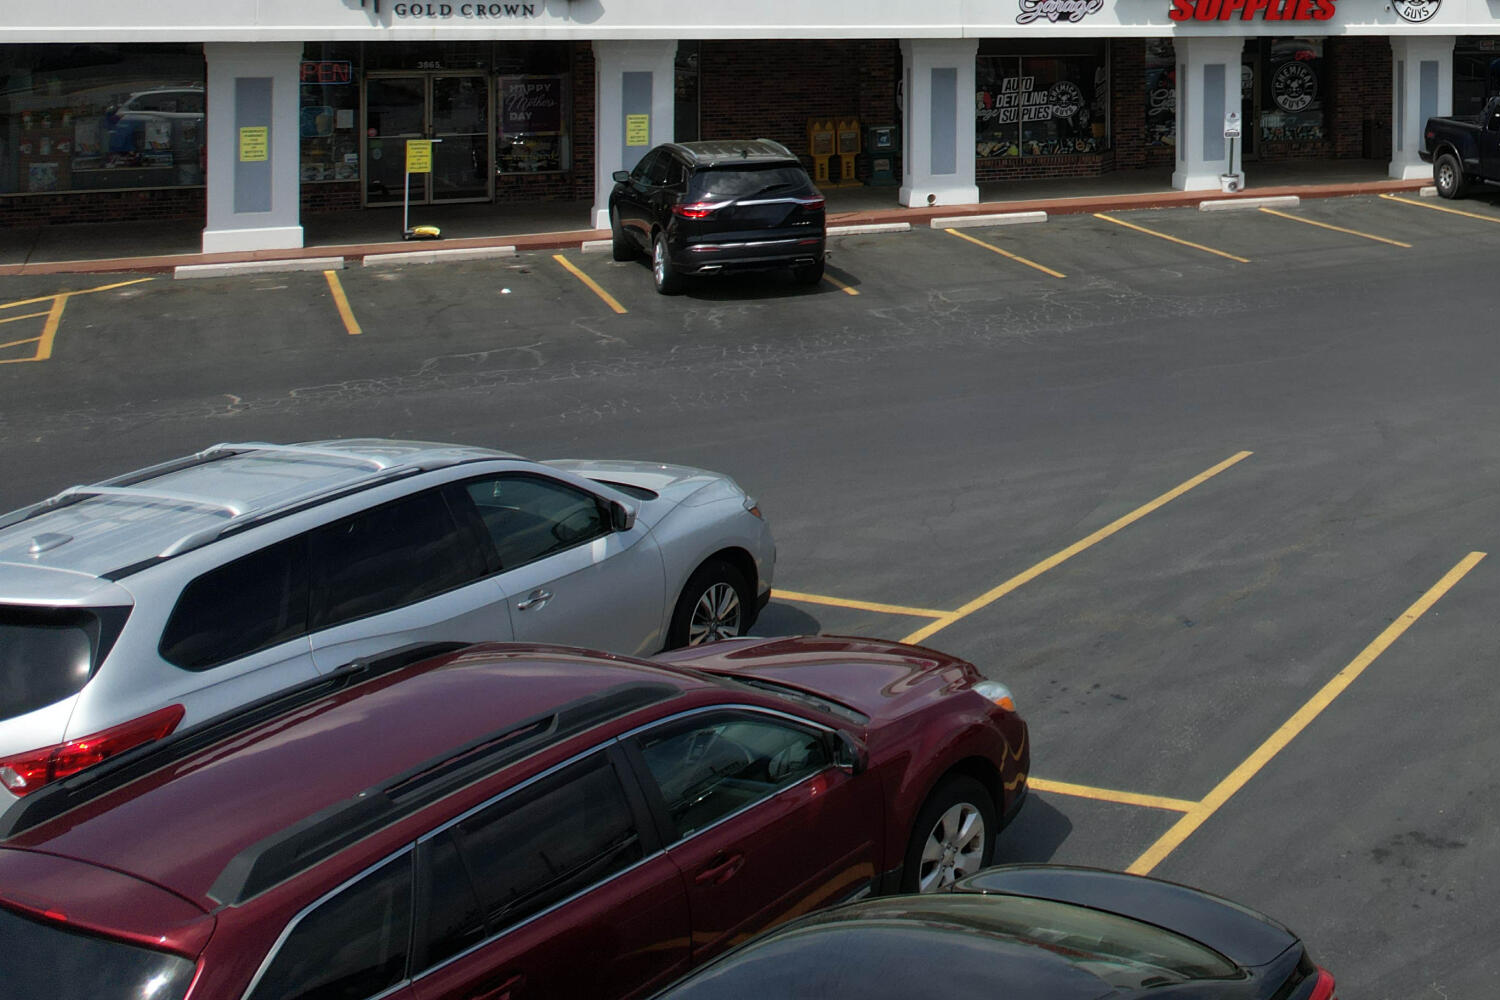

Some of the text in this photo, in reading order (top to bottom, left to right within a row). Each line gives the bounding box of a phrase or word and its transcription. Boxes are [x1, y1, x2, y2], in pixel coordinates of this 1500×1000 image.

[394, 3, 535, 16] GOLD CROWN
[1403, 6, 1430, 19] GUYS
[300, 62, 349, 82] PEN
[1275, 65, 1314, 89] CHEMICAL
[509, 83, 552, 93] HAPPY
[1049, 82, 1079, 101] CHEMICAL
[1282, 98, 1308, 110] GUYS
[509, 111, 532, 121] DAY
